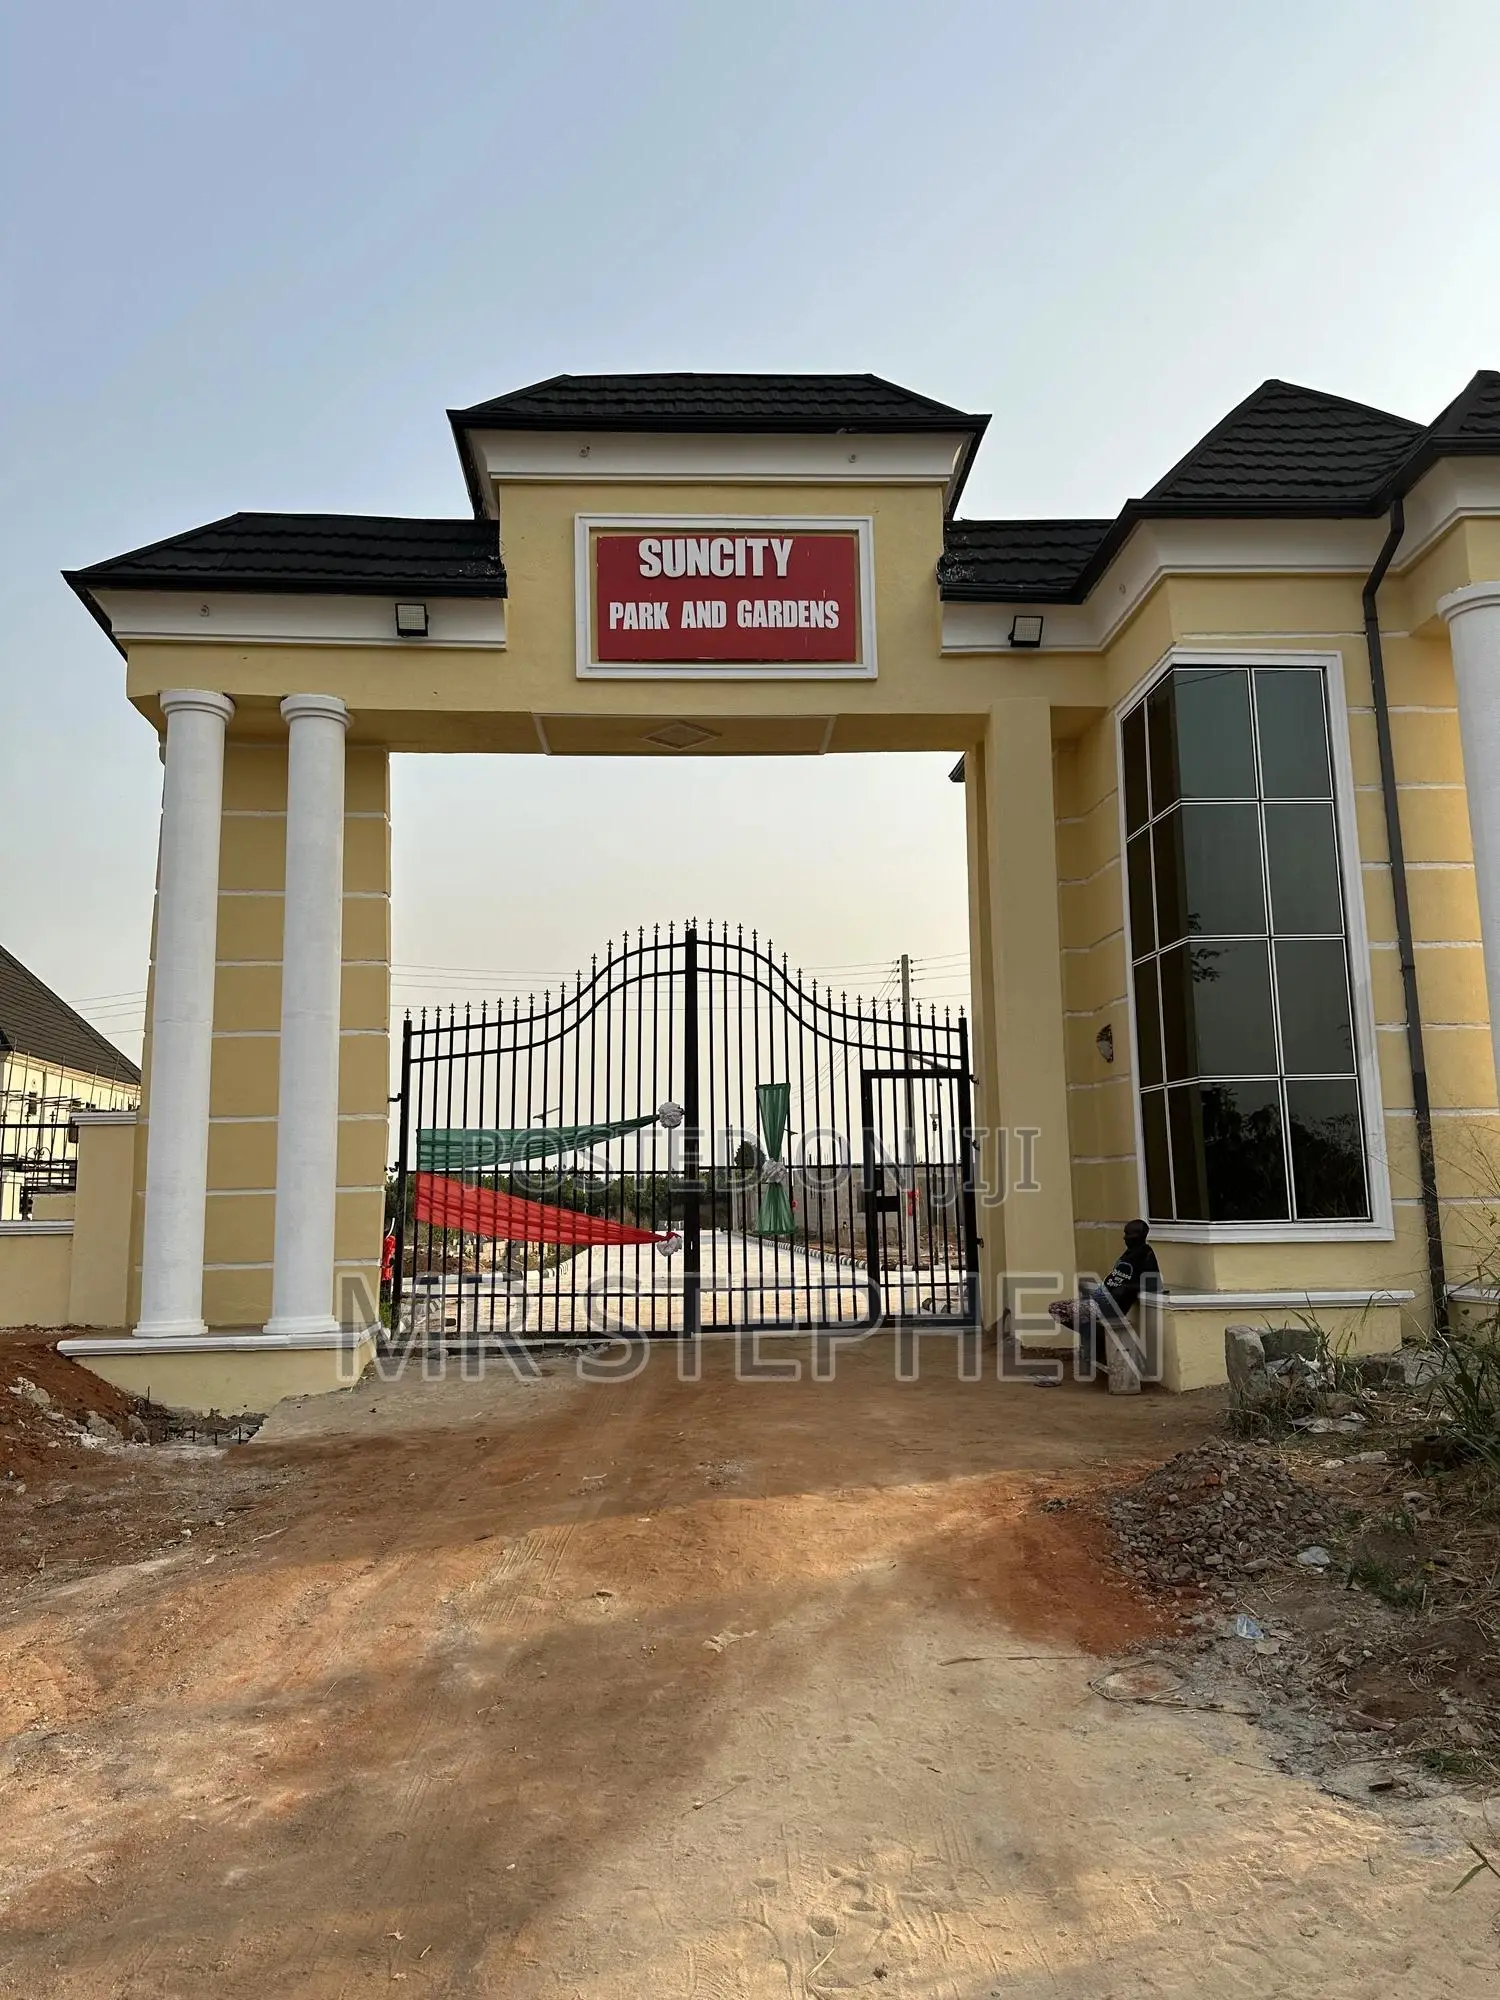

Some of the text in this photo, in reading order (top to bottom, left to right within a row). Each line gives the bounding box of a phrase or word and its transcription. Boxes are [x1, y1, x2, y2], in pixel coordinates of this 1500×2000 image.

[637, 537, 794, 578] SUNCITY
[609, 599, 840, 630] PARK AND GARDENS
